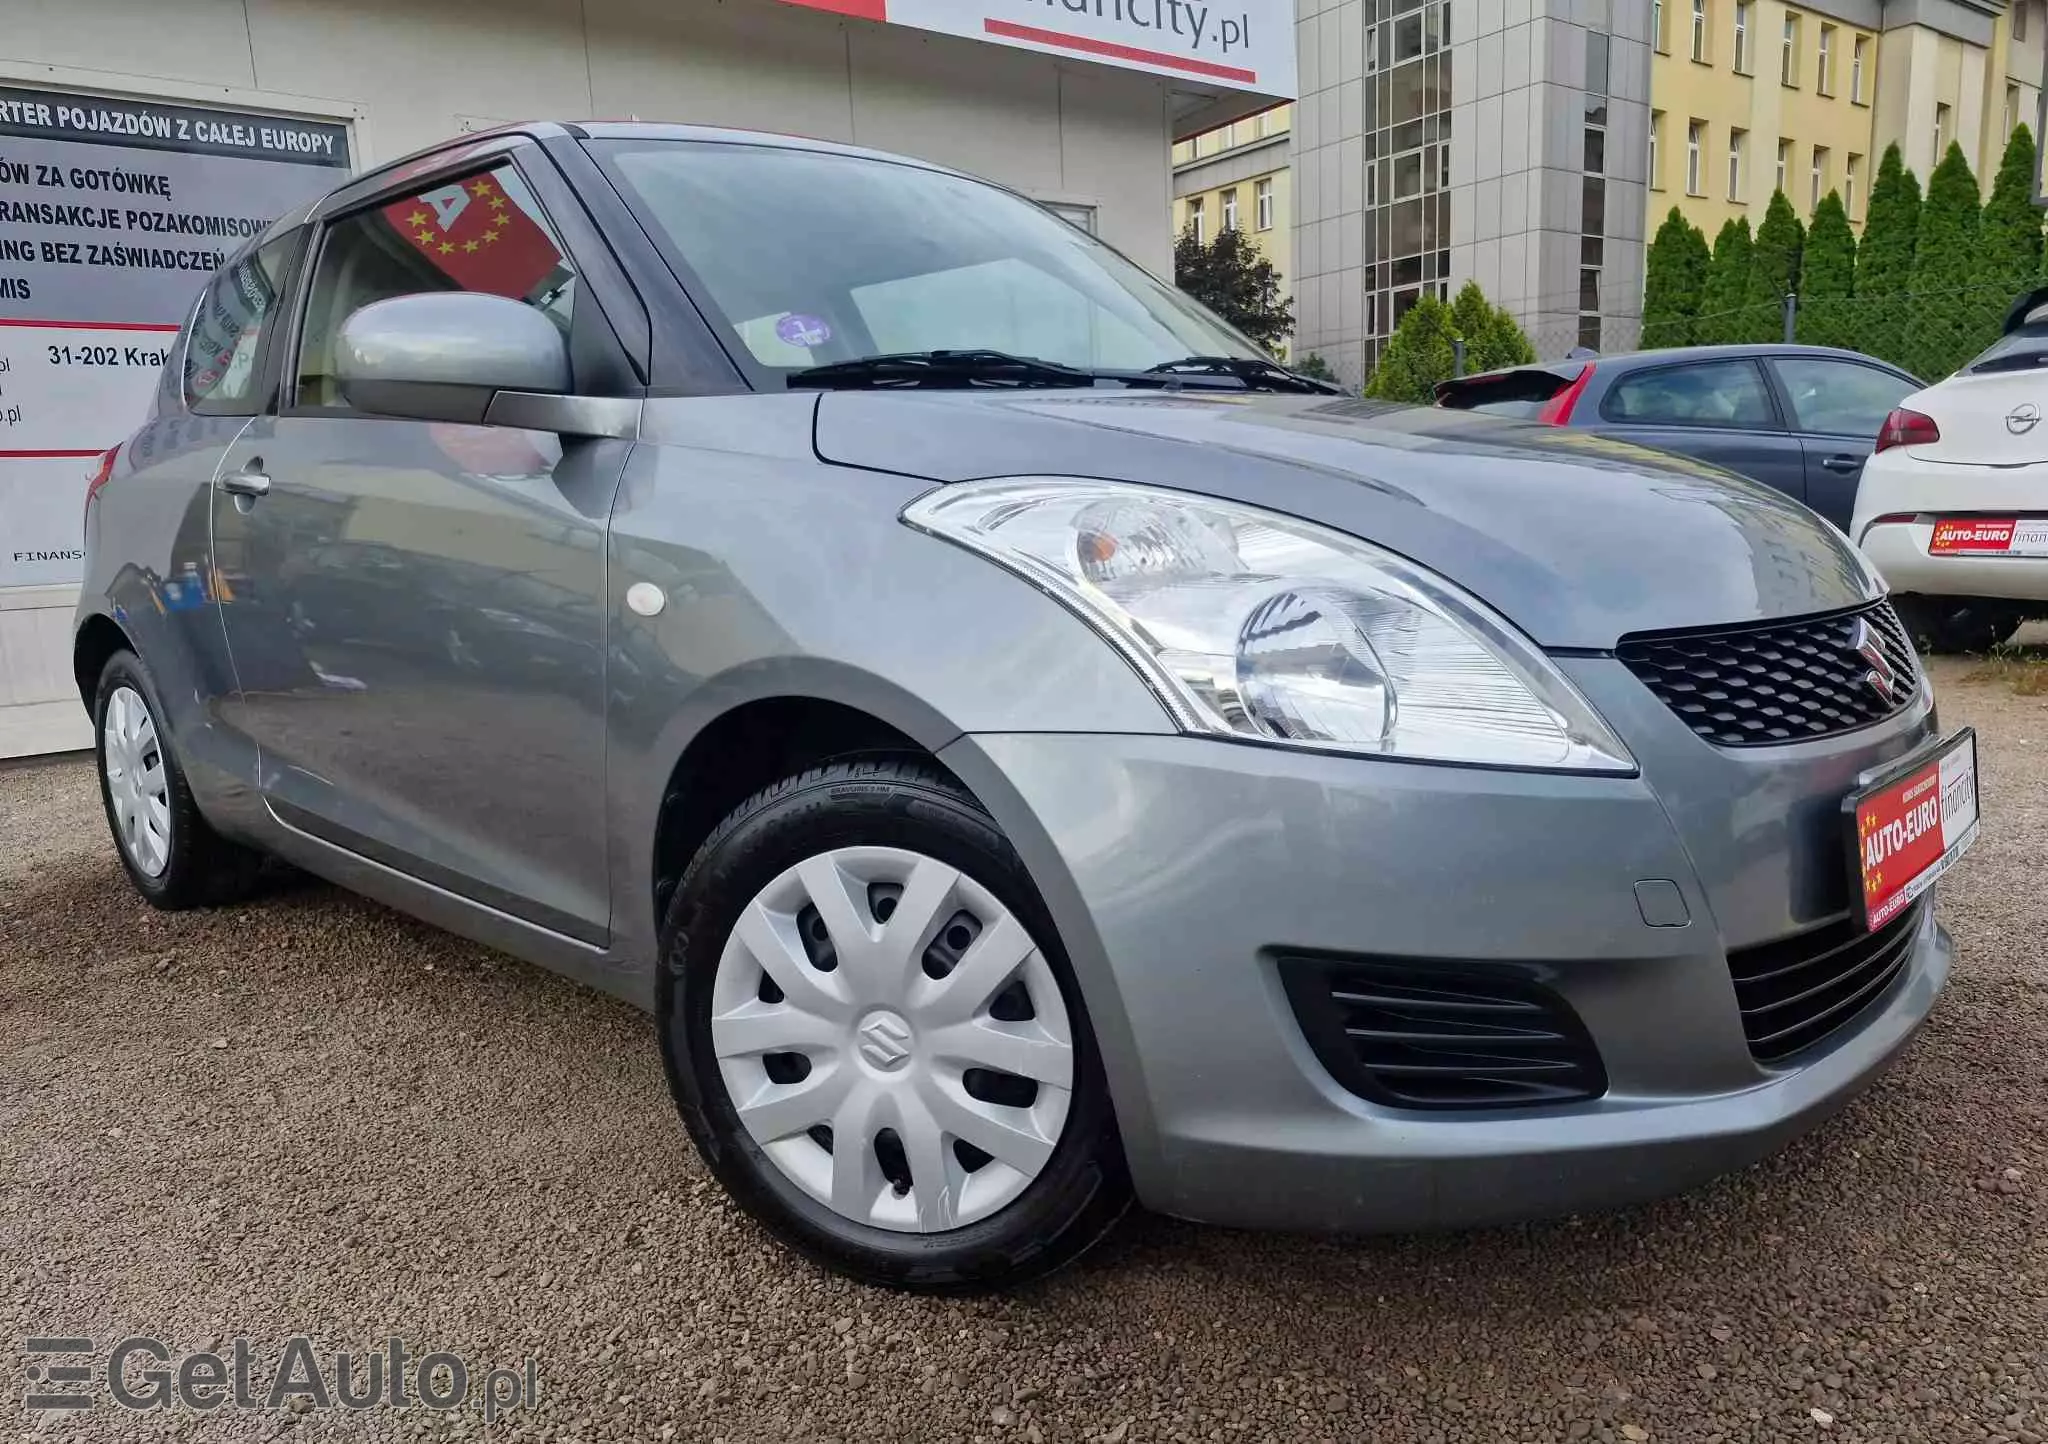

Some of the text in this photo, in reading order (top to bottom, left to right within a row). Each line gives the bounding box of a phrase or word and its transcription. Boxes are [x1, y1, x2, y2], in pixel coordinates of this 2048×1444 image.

[57, 105, 171, 139] POJAZDÓW
[177, 119, 191, 140] Z
[195, 121, 255, 148] CAŁEJ
[261, 128, 334, 154] EUROPY
[36, 165, 65, 187] ZA
[70, 167, 171, 201] GOTÓWKĘ
[0, 200, 273, 239] RANSAKCJE POZAKOMISOW
[40, 242, 82, 264] BEZ
[48, 345, 119, 366] 31-202
[0, 403, 22, 427] .pl
[1940, 529, 2010, 542] AUTO-EURO
[13, 550, 86, 562] FINANS
[1865, 796, 1938, 871] AUTO-EURO
[1872, 891, 1906, 925] AUTO-EURO
